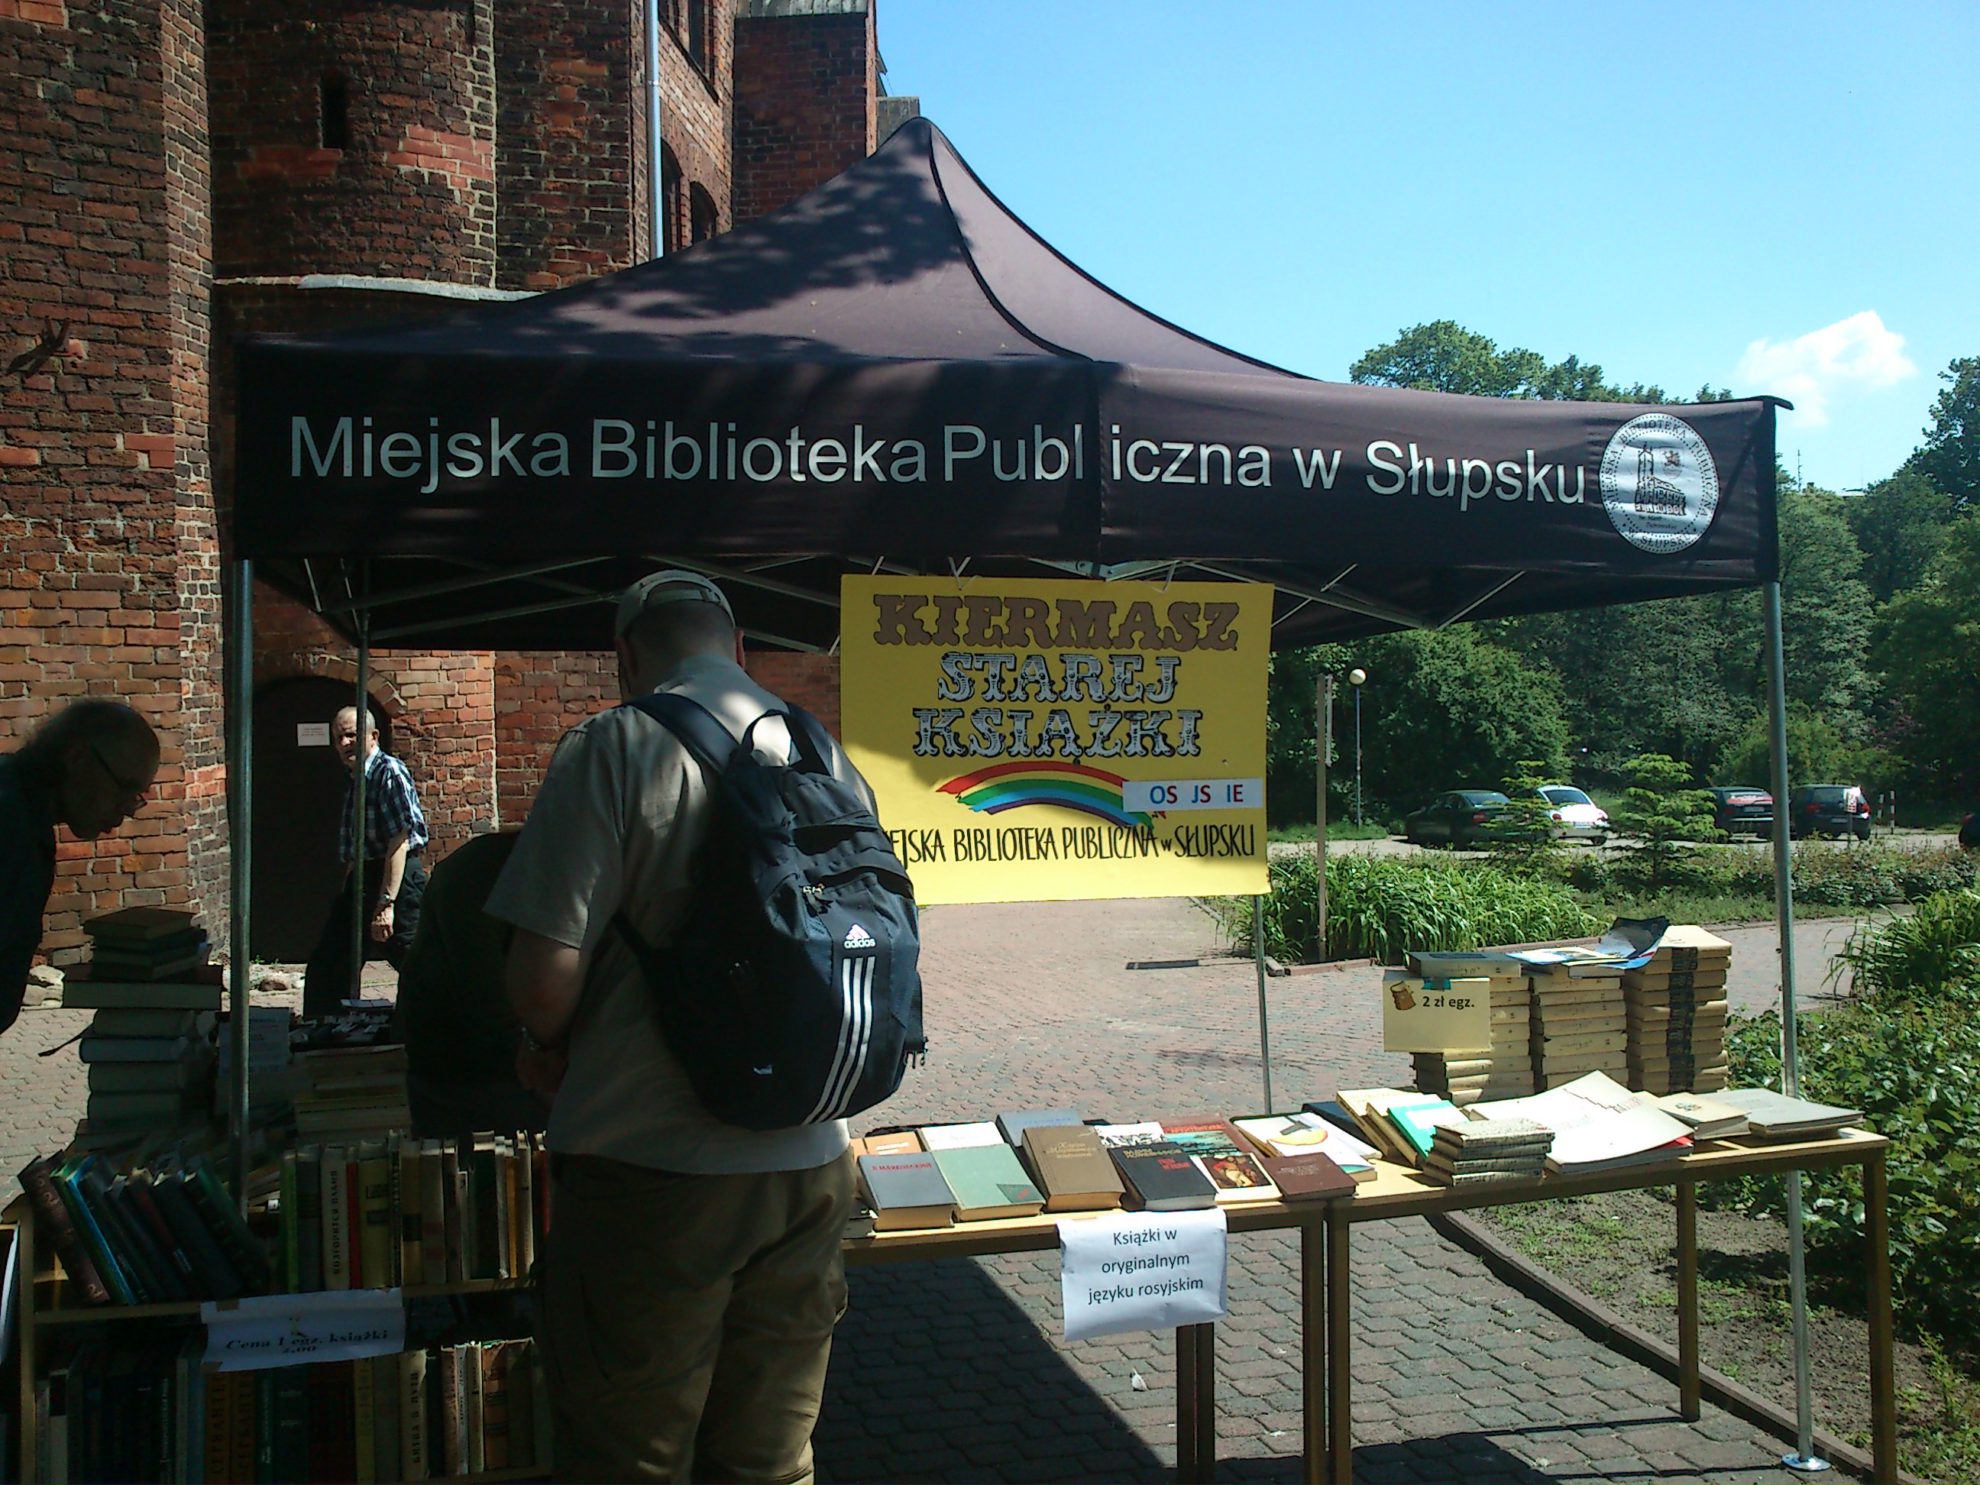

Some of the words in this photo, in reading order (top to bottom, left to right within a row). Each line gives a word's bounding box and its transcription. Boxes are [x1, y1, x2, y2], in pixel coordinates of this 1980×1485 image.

[1619, 419, 1687, 444] BIBLIOTEKA
[290, 415, 572, 494] Miejska
[590, 418, 928, 484] Biblioteka
[1292, 448, 1342, 490] w
[1365, 440, 1586, 512] Słupsku
[873, 594, 1240, 652] KIERMASZ
[937, 652, 1182, 704] STAREJ
[913, 702, 1203, 766] KSIĄŻKI
[884, 828, 947, 870] EJSKA
[953, 827, 1059, 863] BIBLIOTEKA
[1063, 825, 1159, 861] PUBLICZNA
[1174, 824, 1255, 858] SŁUPSKU
[843, 937, 877, 949] adidas
[1422, 995, 1431, 1008] 2
[1434, 995, 1445, 1008] zł
[1448, 998, 1475, 1011] egz.
[1113, 1229, 1161, 1247] Książki
[1165, 1229, 1178, 1241] w
[1101, 1254, 1190, 1275] oryginalnym
[1088, 1284, 1134, 1305] języku
[1138, 1277, 1204, 1297] rosyjskim
